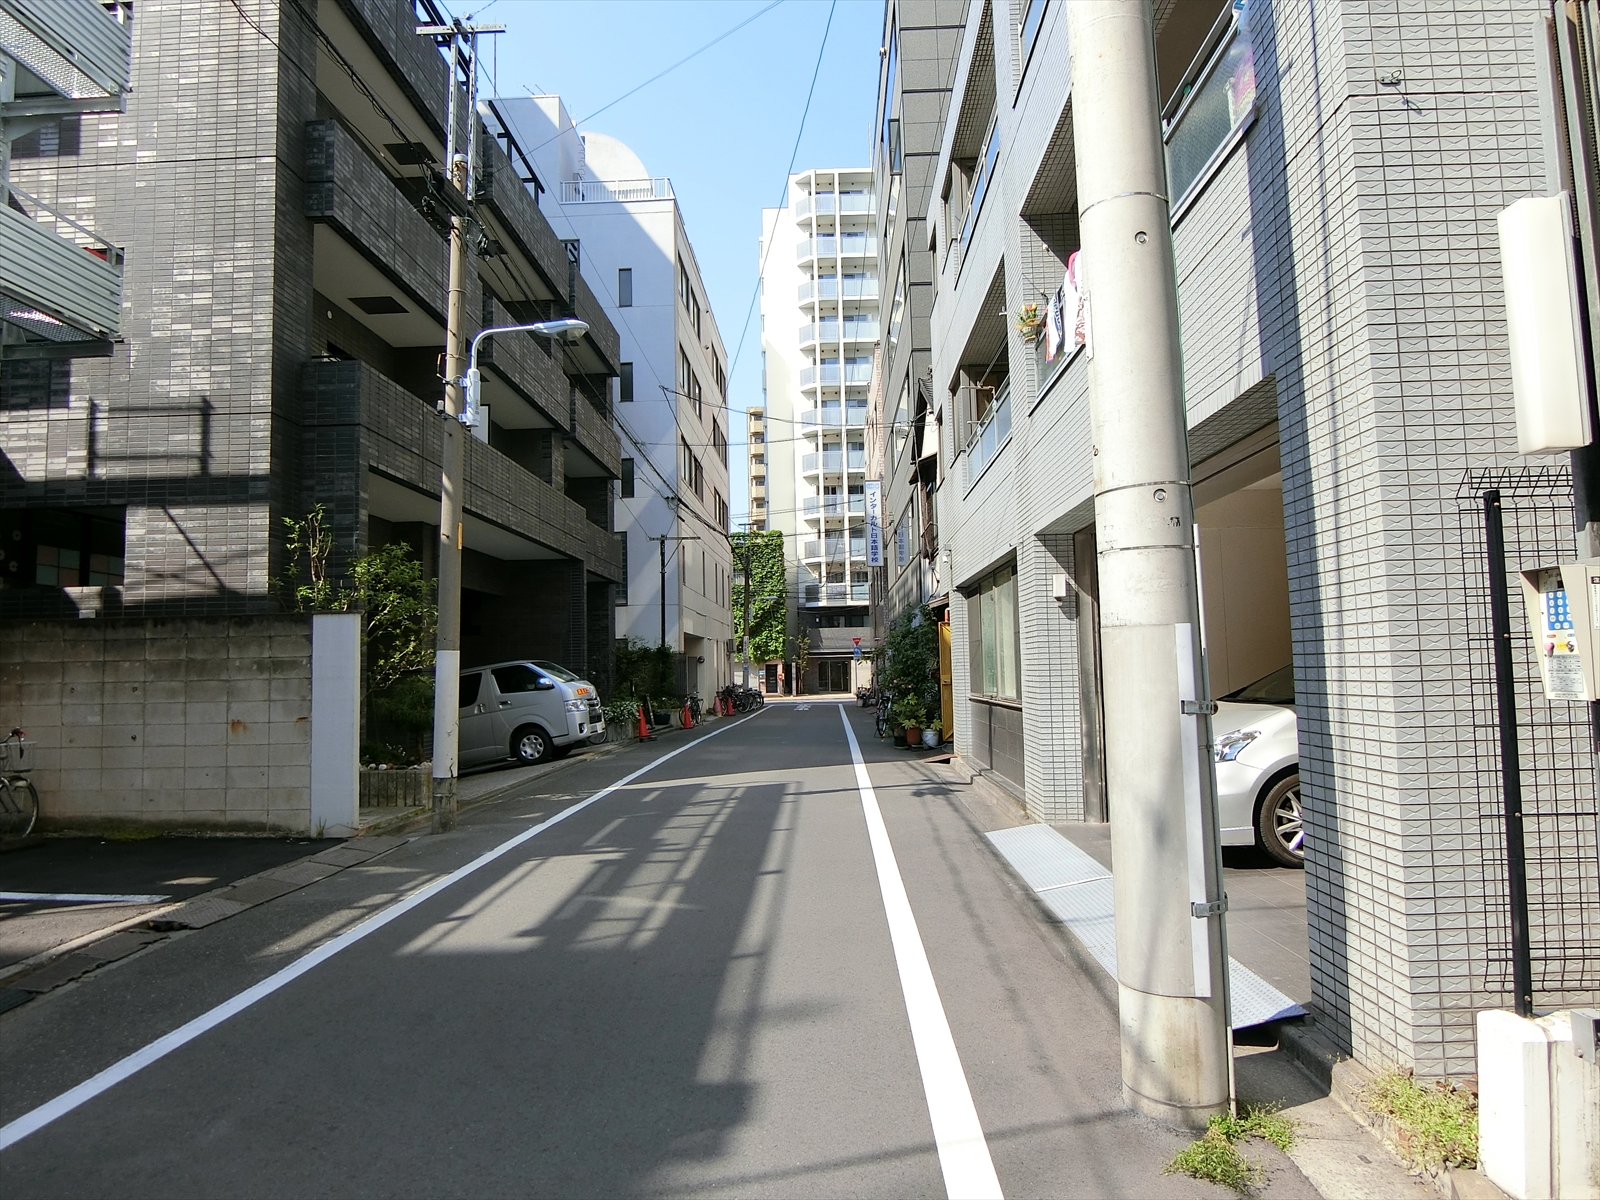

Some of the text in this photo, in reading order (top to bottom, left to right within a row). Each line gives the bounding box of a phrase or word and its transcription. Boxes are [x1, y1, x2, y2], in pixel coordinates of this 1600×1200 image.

[869, 491, 879, 563] インターカルト日本語学校
